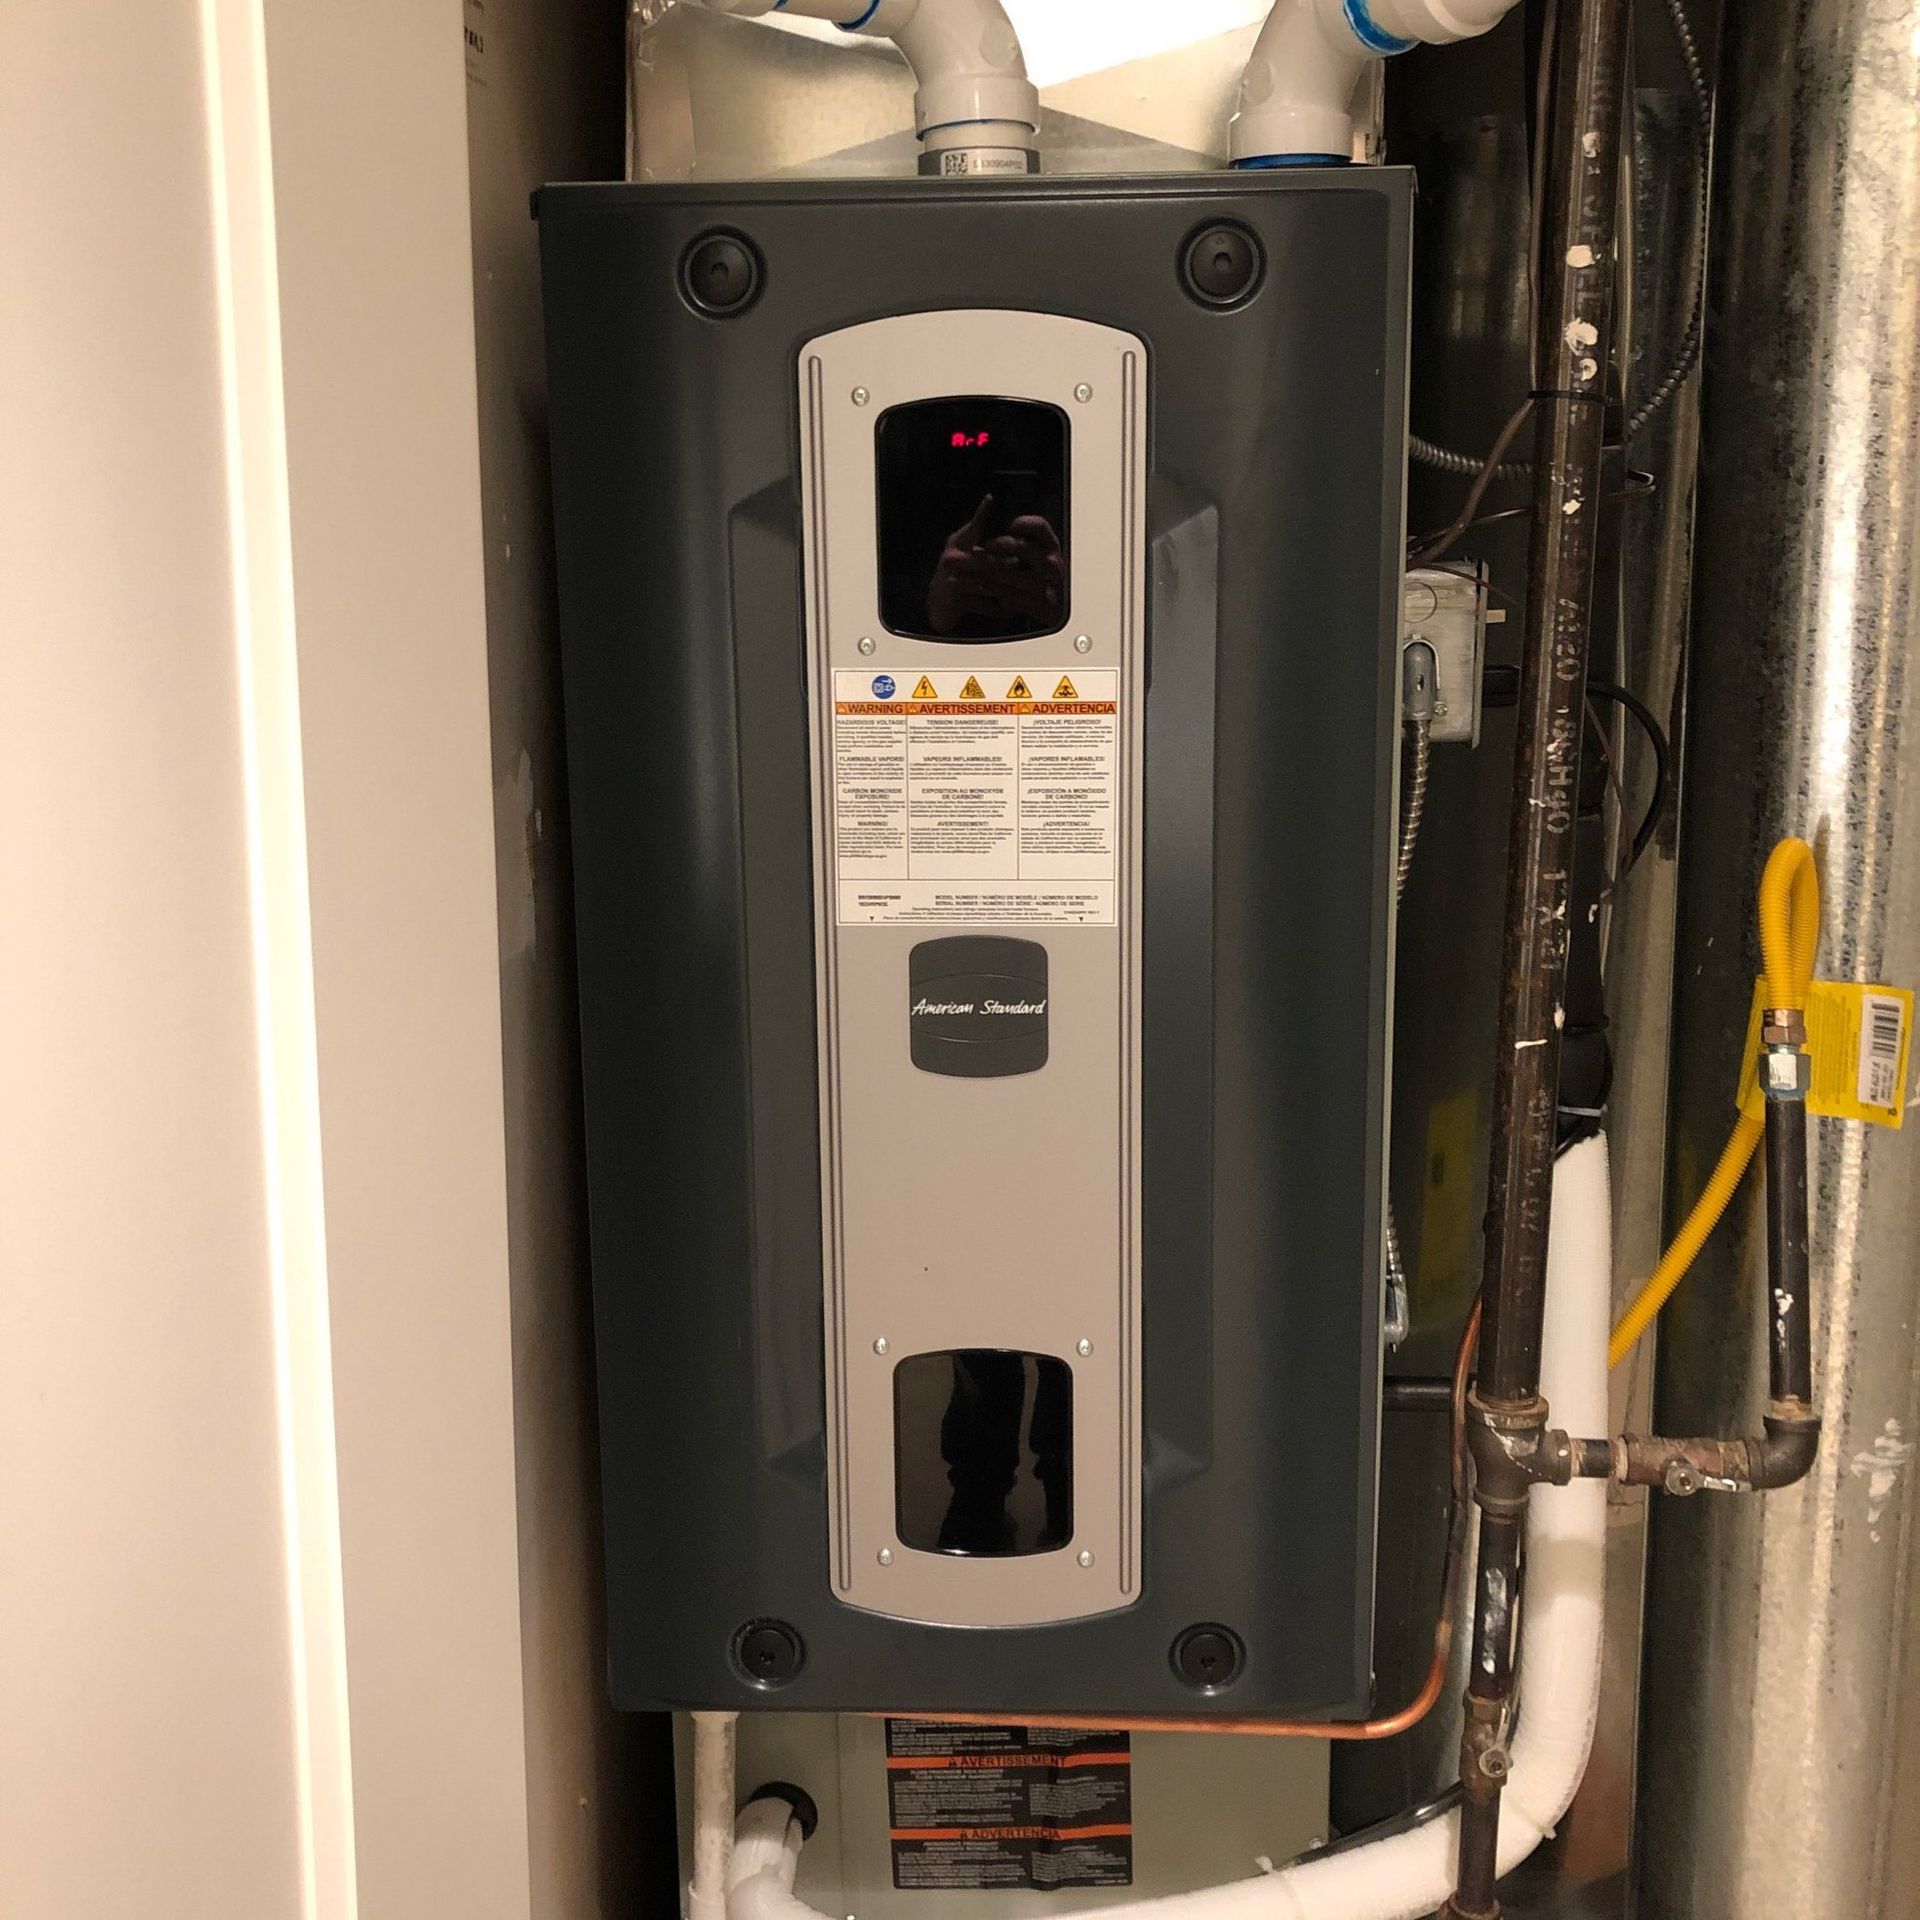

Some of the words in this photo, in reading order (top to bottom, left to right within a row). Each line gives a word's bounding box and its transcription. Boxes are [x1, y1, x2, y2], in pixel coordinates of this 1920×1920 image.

[848, 704, 903, 714] WARNING
[920, 704, 1015, 714] AVERTISSEMENT
[1032, 703, 1115, 714] ADVERTENCIA
[911, 998, 974, 1016] American
[979, 1000, 1047, 1015] Standard
